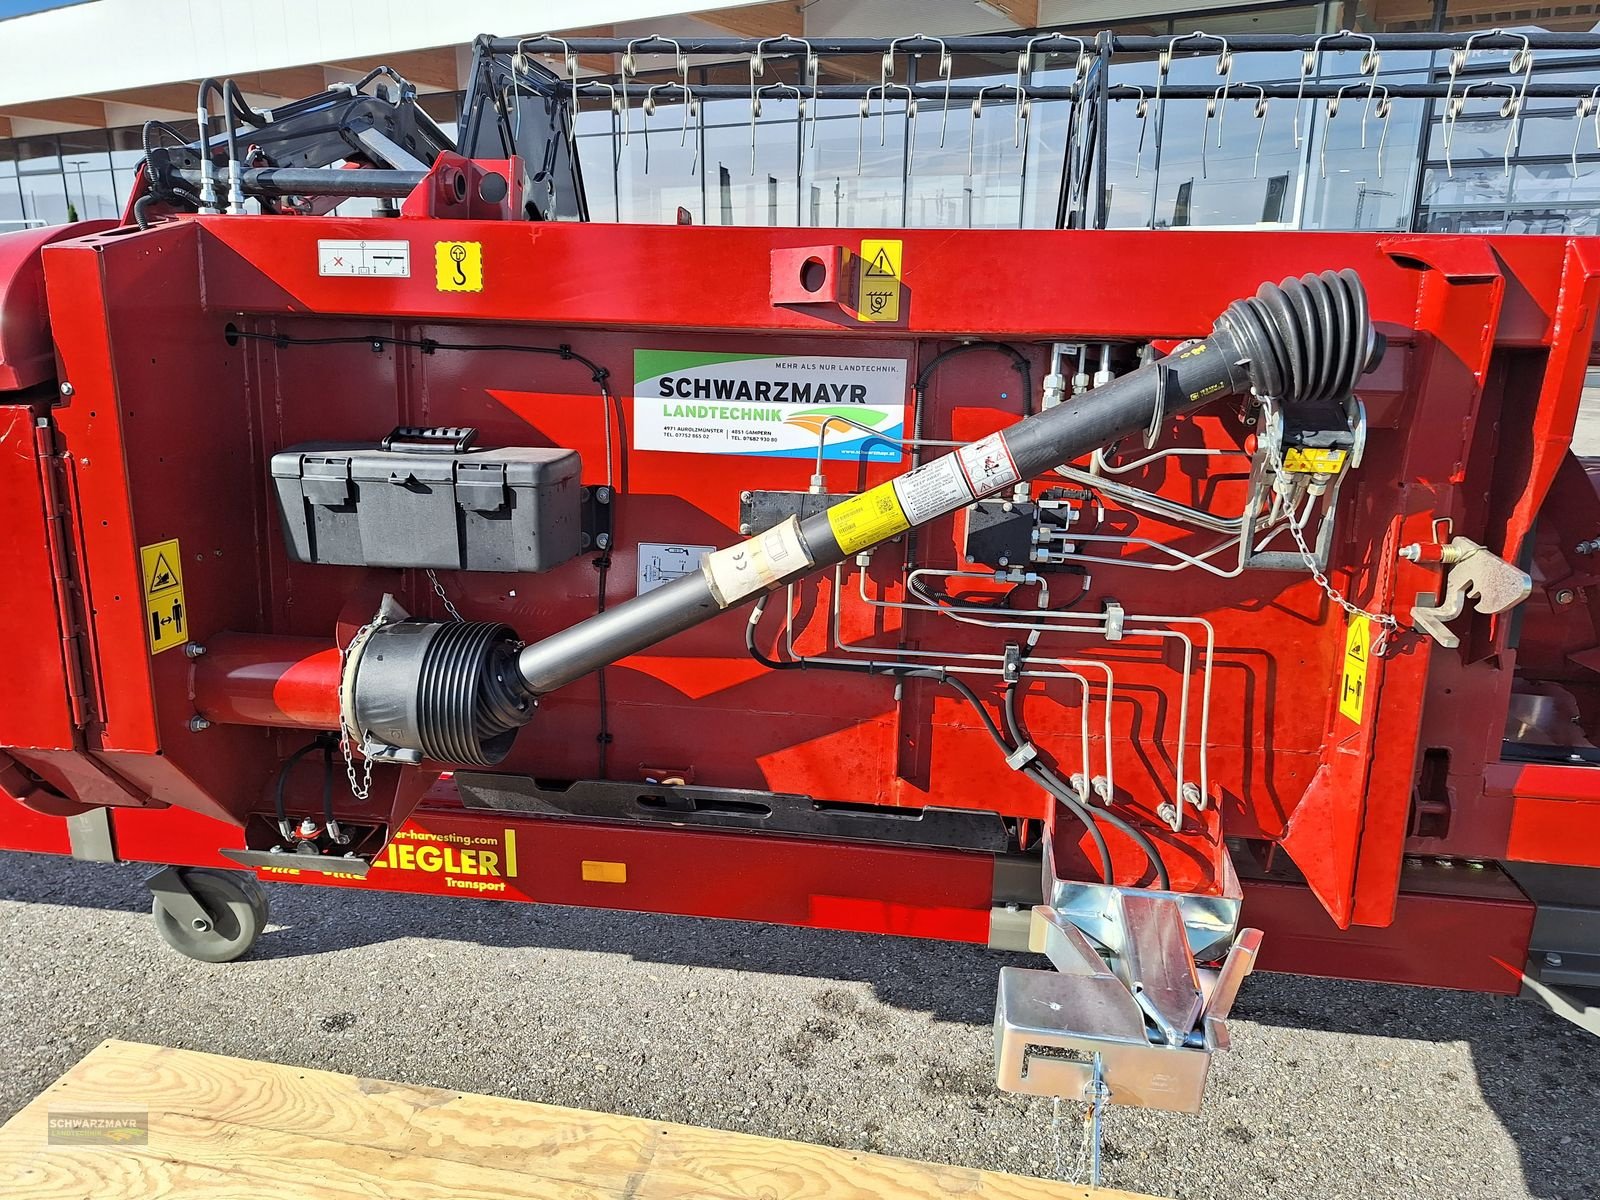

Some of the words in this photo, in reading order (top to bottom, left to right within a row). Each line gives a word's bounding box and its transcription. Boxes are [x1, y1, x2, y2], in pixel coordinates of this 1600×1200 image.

[839, 365, 899, 373] LANDTECHNIK.
[659, 376, 867, 404] SCHWARZMAYR
[663, 404, 782, 422] LANDTECHNIK
[395, 829, 498, 846] er-harvesting.com
[445, 877, 506, 892] Transport
